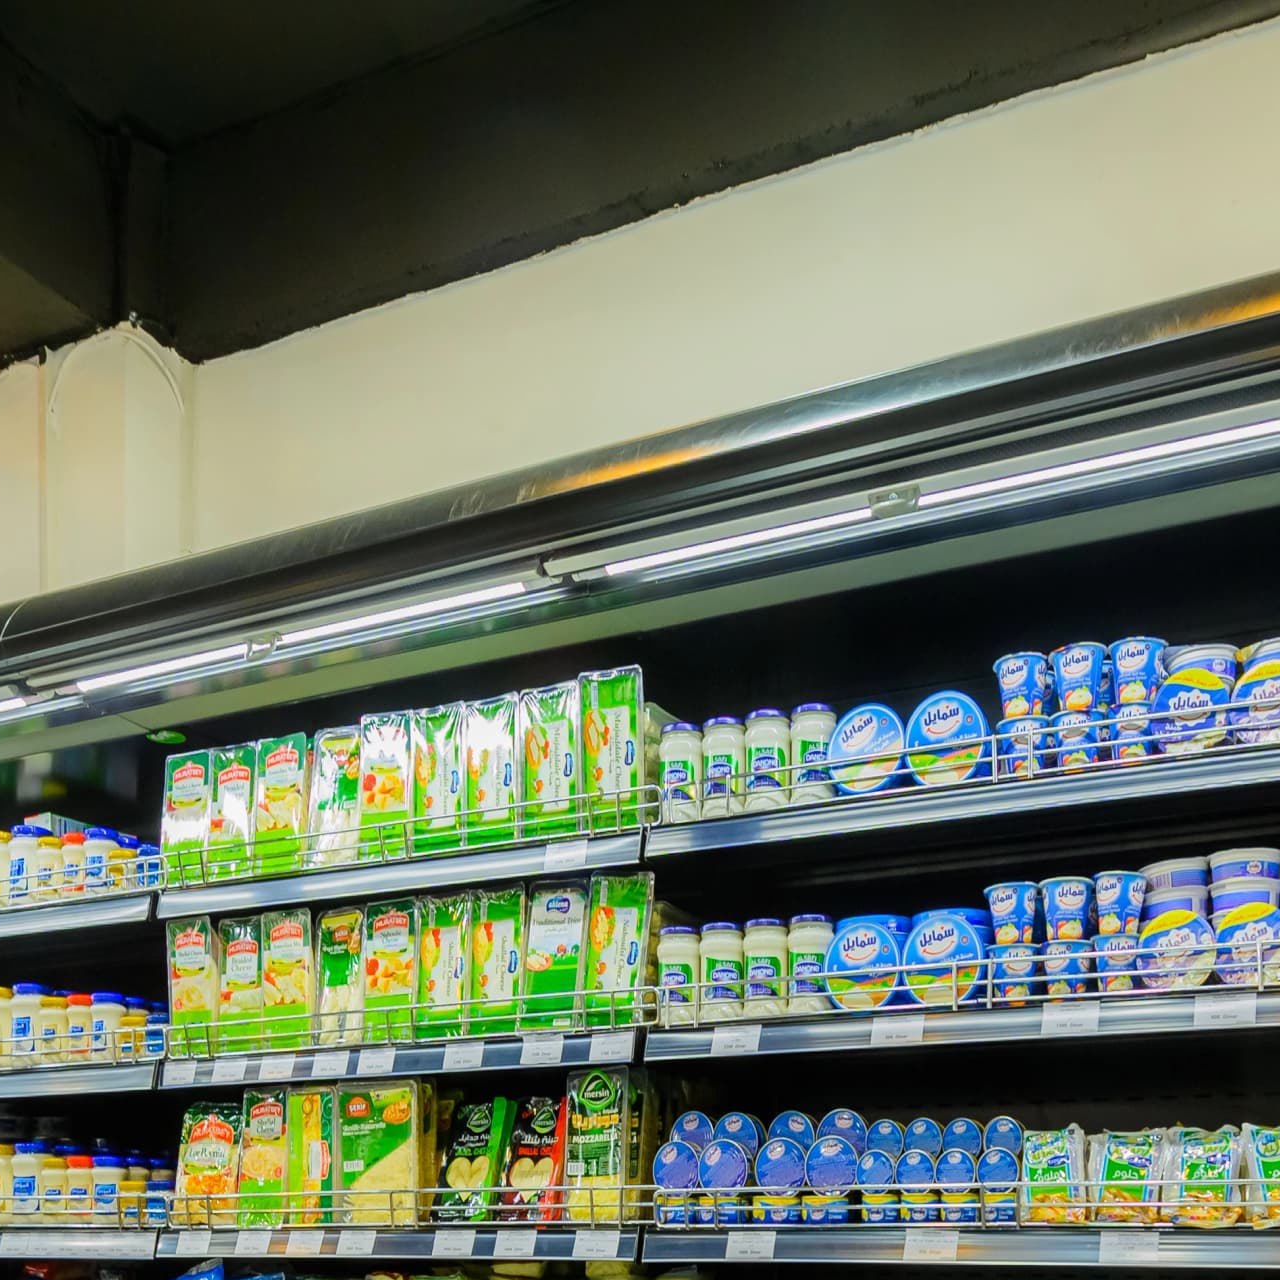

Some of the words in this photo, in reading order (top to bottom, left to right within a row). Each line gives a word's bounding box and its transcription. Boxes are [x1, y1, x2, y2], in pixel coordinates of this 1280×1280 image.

[923, 704, 960, 726] سمايل
[841, 715, 874, 744] سمايل
[843, 933, 878, 952] سمايل
[919, 926, 955, 948] سمايل
[584, 1088, 610, 1099] mersin
[572, 1133, 618, 1144] MOZZARELLA
